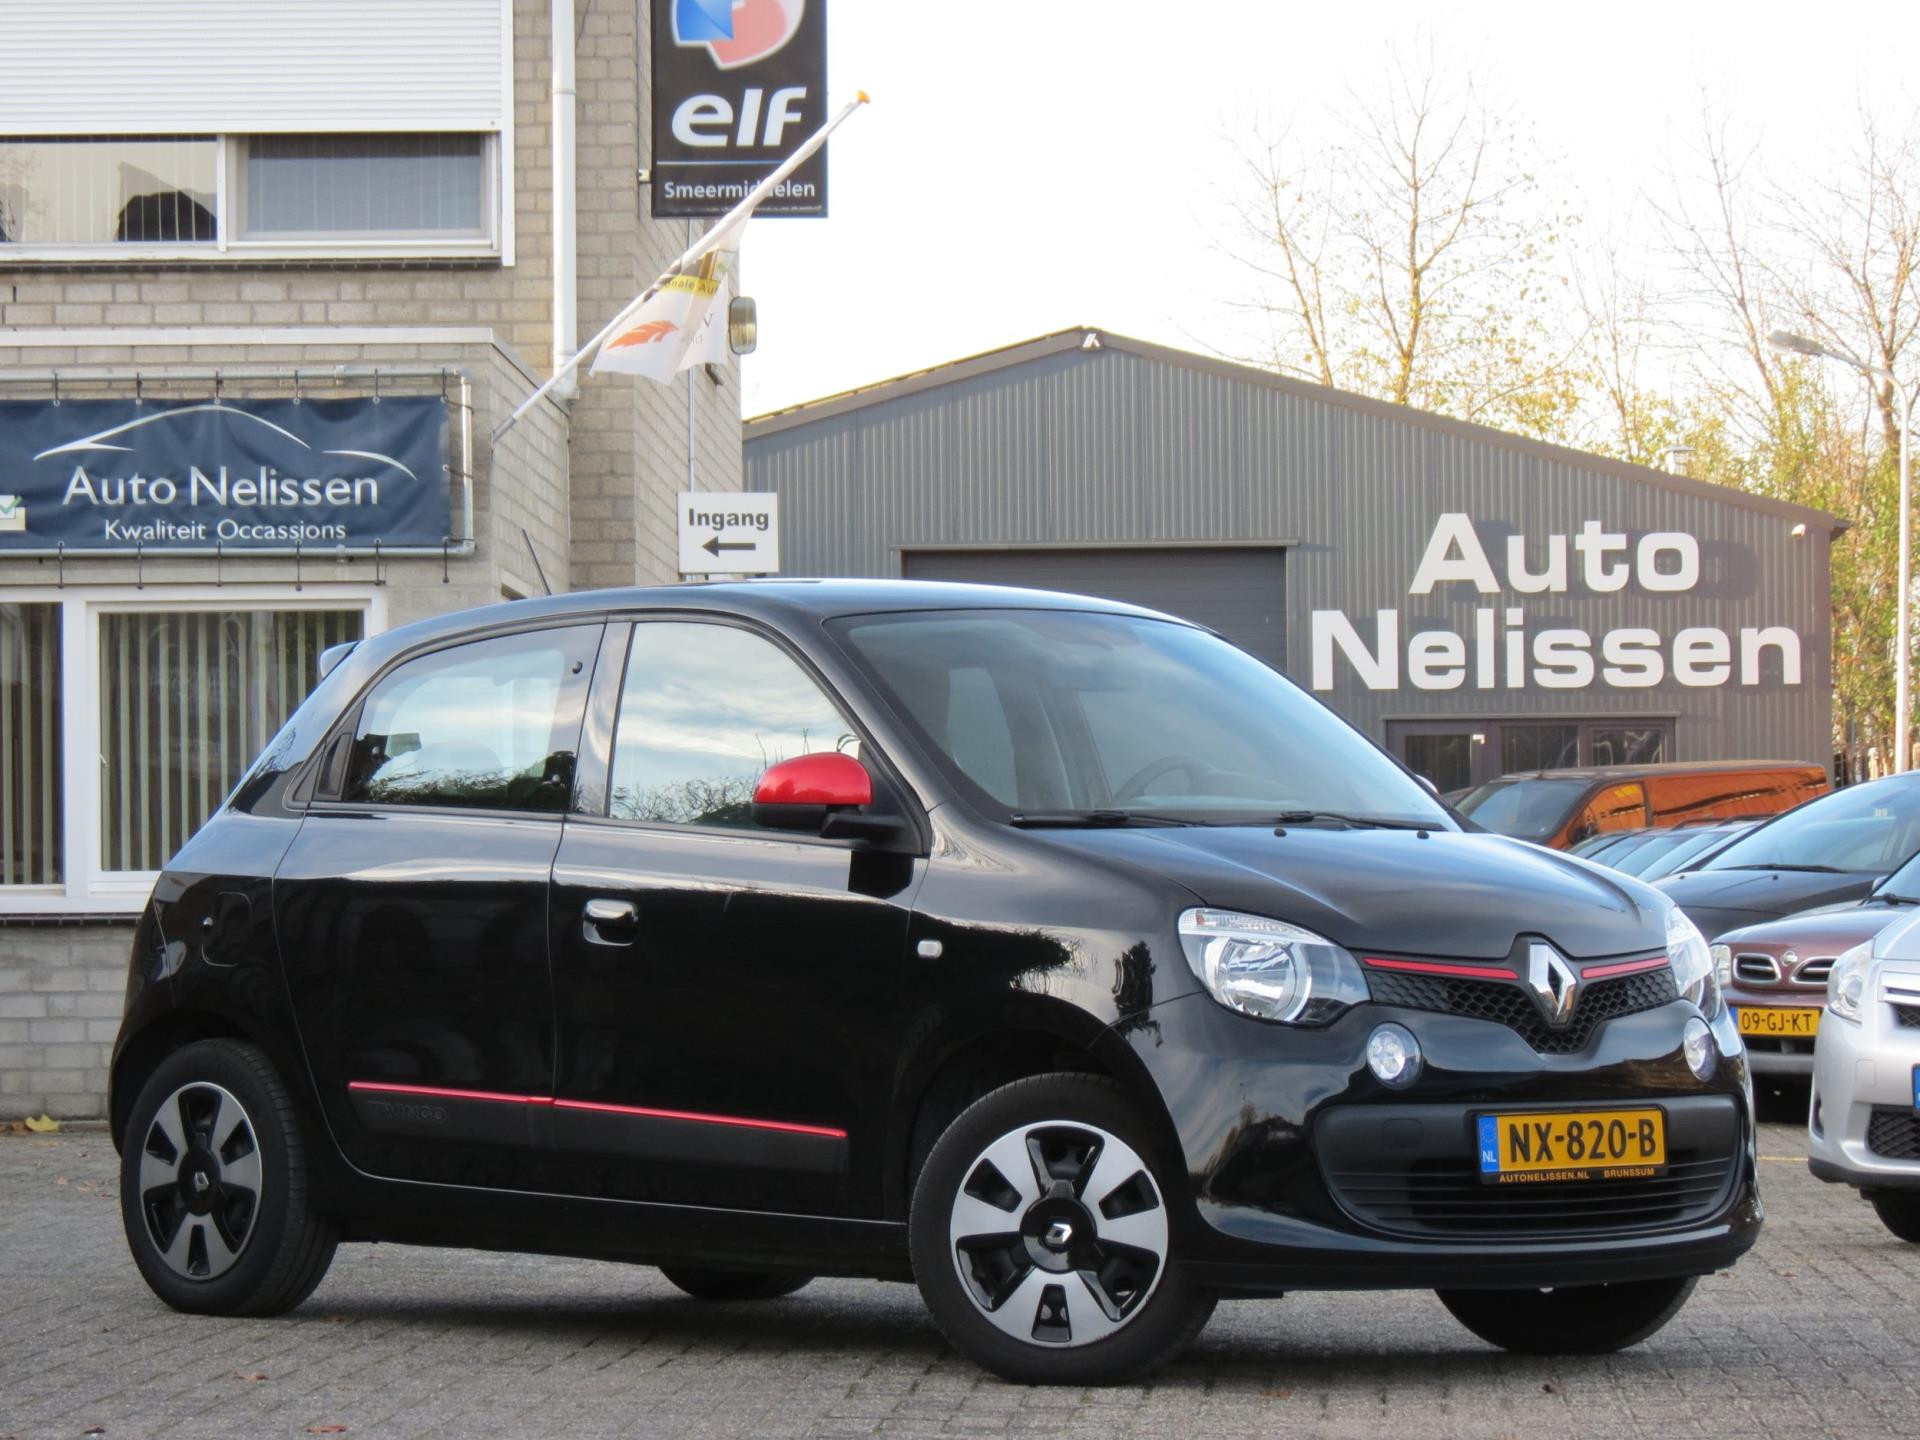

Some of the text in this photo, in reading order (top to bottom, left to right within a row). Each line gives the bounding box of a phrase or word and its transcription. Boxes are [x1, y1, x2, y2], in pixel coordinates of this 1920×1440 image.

[671, 86, 807, 147] elf
[664, 180, 815, 198] Smeermielen
[62, 465, 379, 507] Auto Nelissen
[104, 518, 347, 541] Kwaliteit Occassions
[688, 507, 769, 531] Ingang
[1408, 512, 1700, 594] Auto
[1311, 607, 1801, 690] Nelissen
[1741, 1013, 1812, 1032] 09-GJ-KT
[1509, 1118, 1656, 1164] NX-820-B
[1482, 1150, 1497, 1163] NL
[1499, 1167, 1655, 1183] AUTONELISSEN.NL BRUNSSUM
